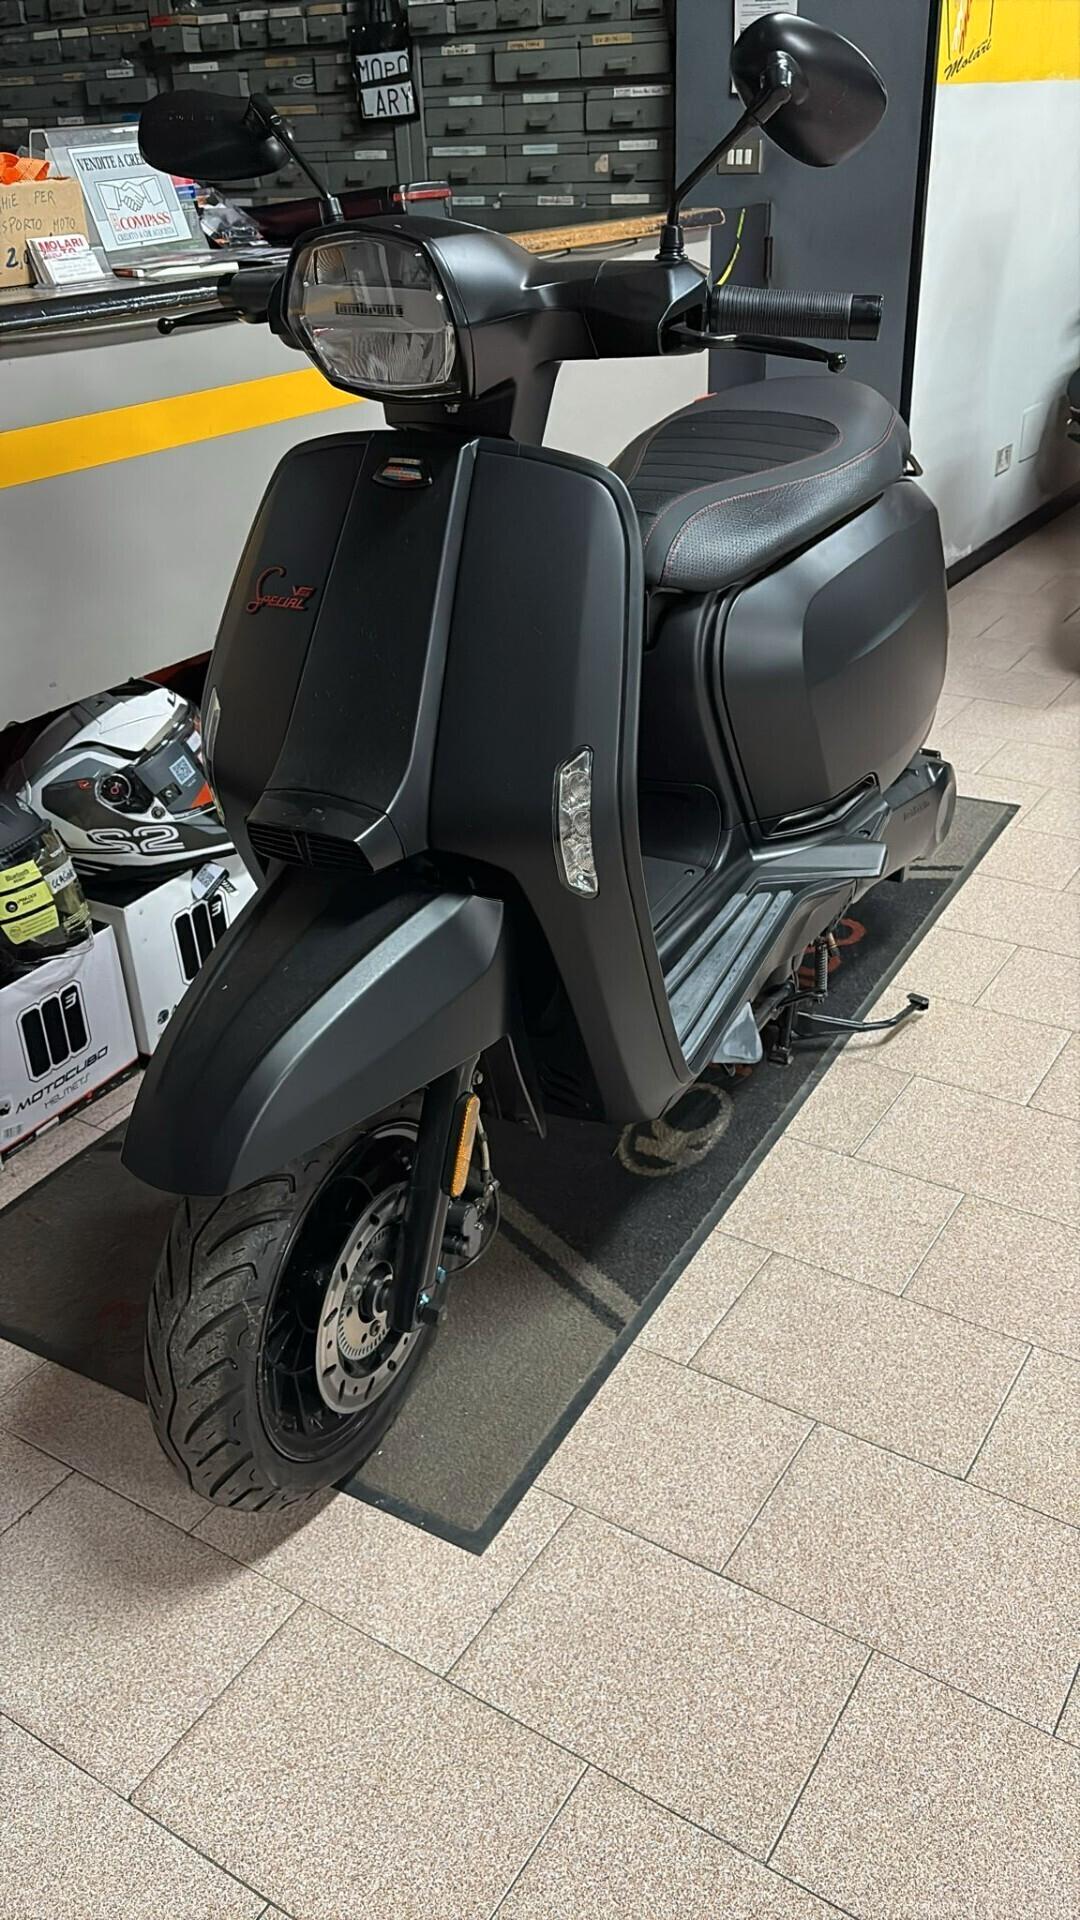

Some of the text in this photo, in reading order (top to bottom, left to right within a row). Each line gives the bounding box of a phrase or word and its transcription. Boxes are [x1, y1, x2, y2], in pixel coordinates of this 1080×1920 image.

[361, 85, 411, 117] LARY
[77, 155, 117, 172] VENDITE
[117, 153, 126, 169] A
[34, 190, 57, 209] PER
[53, 216, 76, 232] MOTO
[120, 211, 171, 231] COMPASS
[37, 238, 84, 252] MOLARI
[15, 1045, 109, 1114] MOTOCUBO
[44, 1072, 91, 1110] HELMETS
